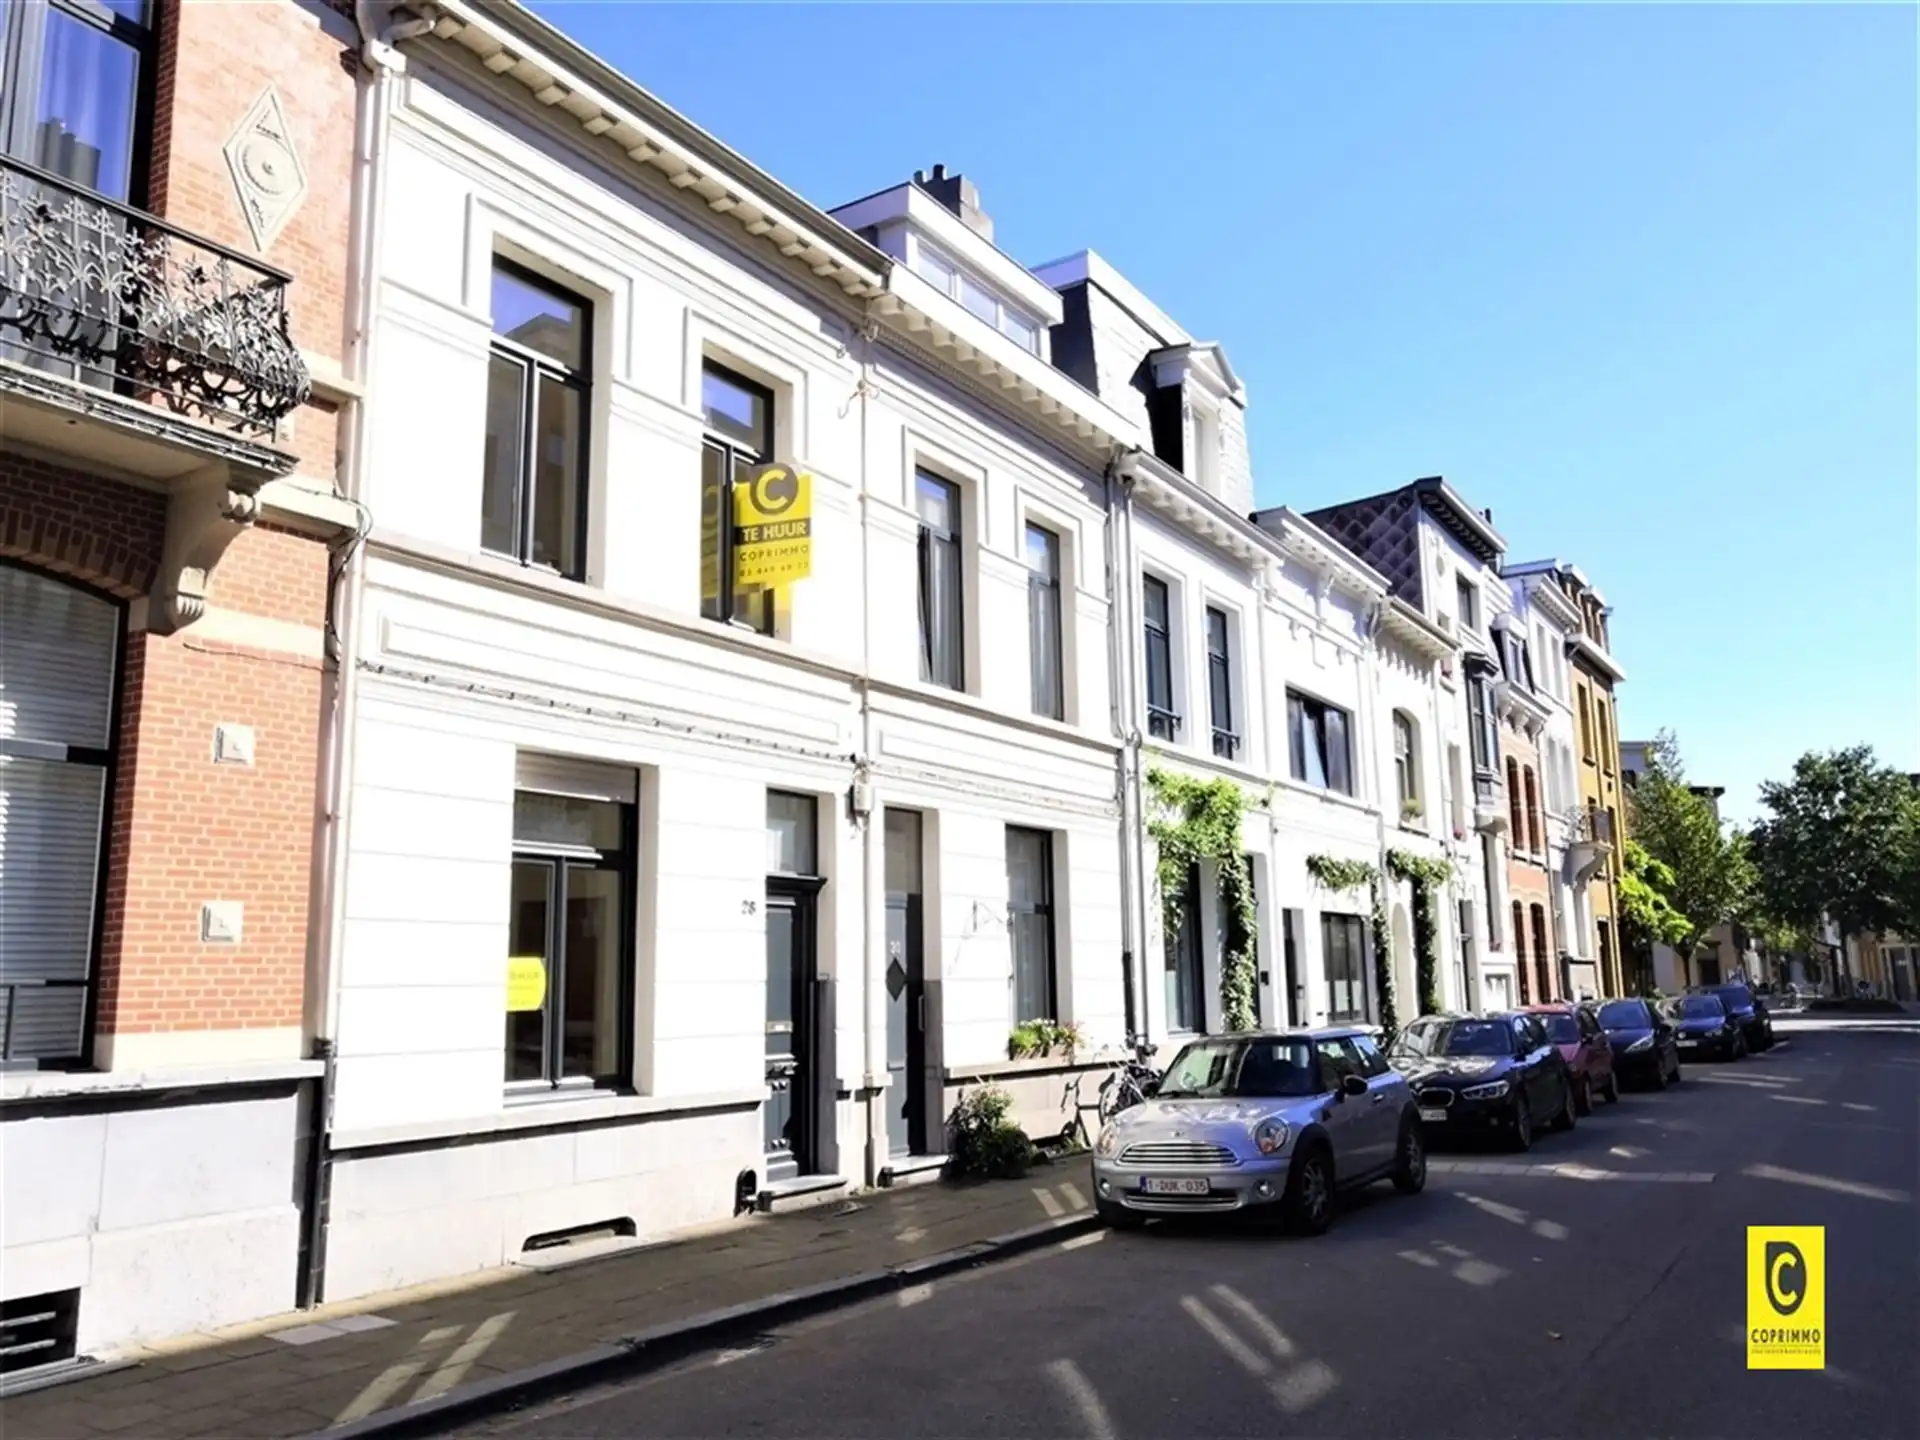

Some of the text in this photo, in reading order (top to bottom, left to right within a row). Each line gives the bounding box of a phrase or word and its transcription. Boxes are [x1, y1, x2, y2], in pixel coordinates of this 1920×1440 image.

[742, 522, 807, 542] TE HUUR
[739, 544, 809, 562] COPRIMMO
